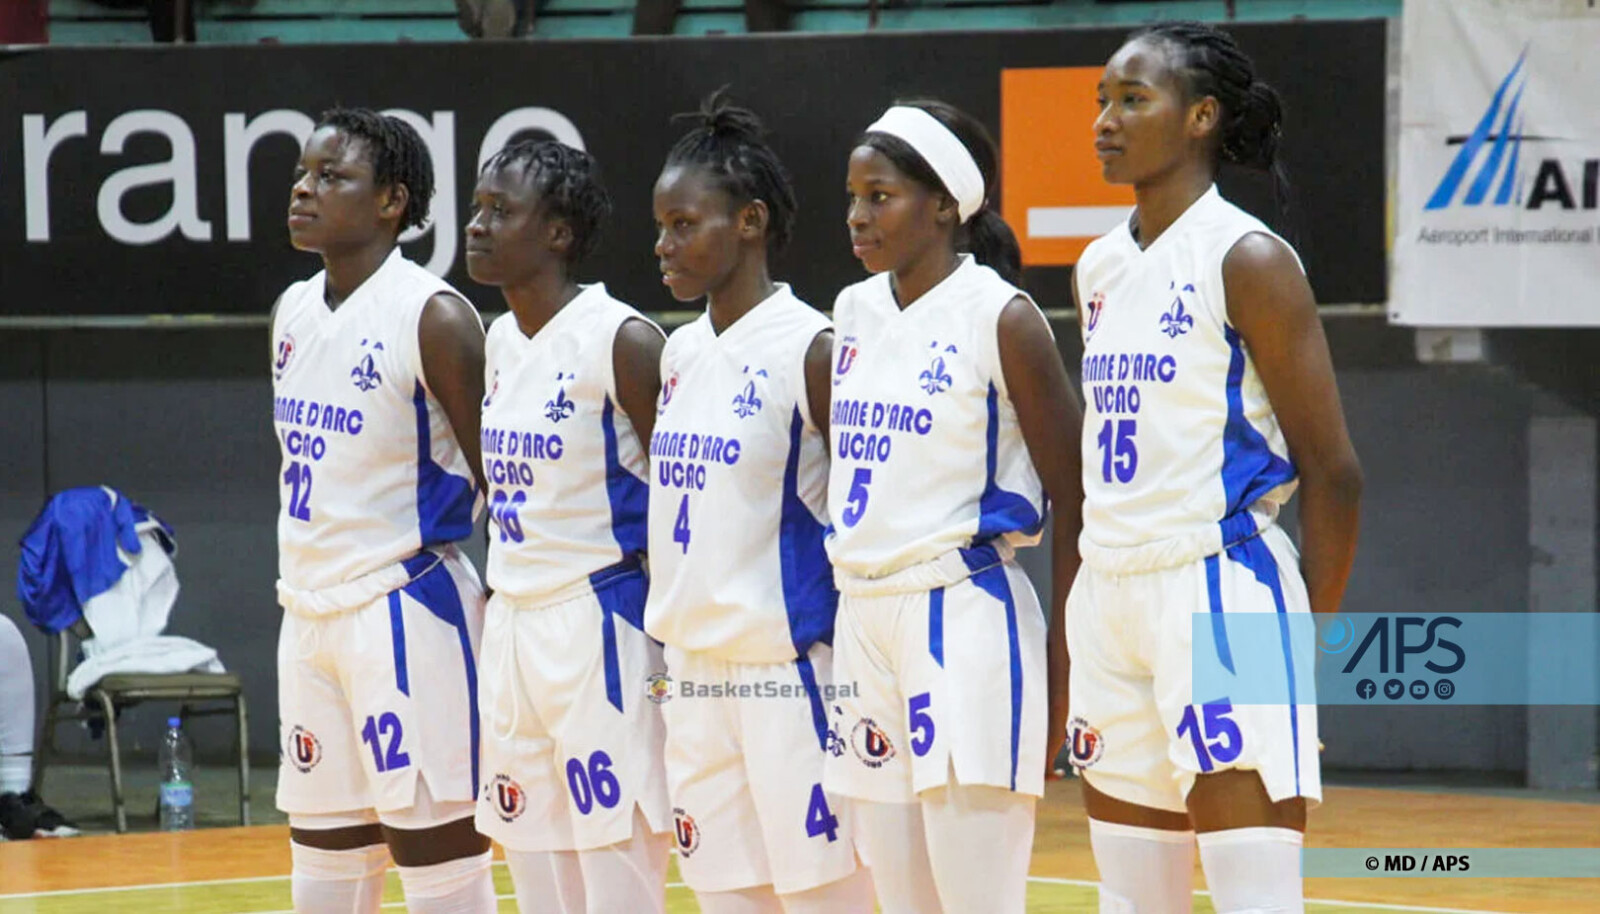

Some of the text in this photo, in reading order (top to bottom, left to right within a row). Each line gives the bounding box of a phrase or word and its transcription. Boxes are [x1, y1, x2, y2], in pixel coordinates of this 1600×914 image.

[1118, 353, 1176, 383] D'ARC
[306, 402, 364, 435] D'ARC
[871, 402, 932, 435] D'ARC
[1093, 385, 1140, 414] UCAO
[507, 431, 563, 460] D'ARC
[689, 433, 741, 465] D'ARC
[838, 432, 891, 462] UCAO
[1098, 419, 1138, 483] 15
[284, 461, 313, 522] 12
[659, 460, 706, 491] UCAO
[842, 468, 872, 528] 5
[673, 494, 691, 554] 4
[362, 712, 411, 772] 12
[909, 692, 935, 757] 5
[1177, 697, 1243, 773] 15
[566, 750, 620, 815] 06
[806, 783, 839, 842] 4
